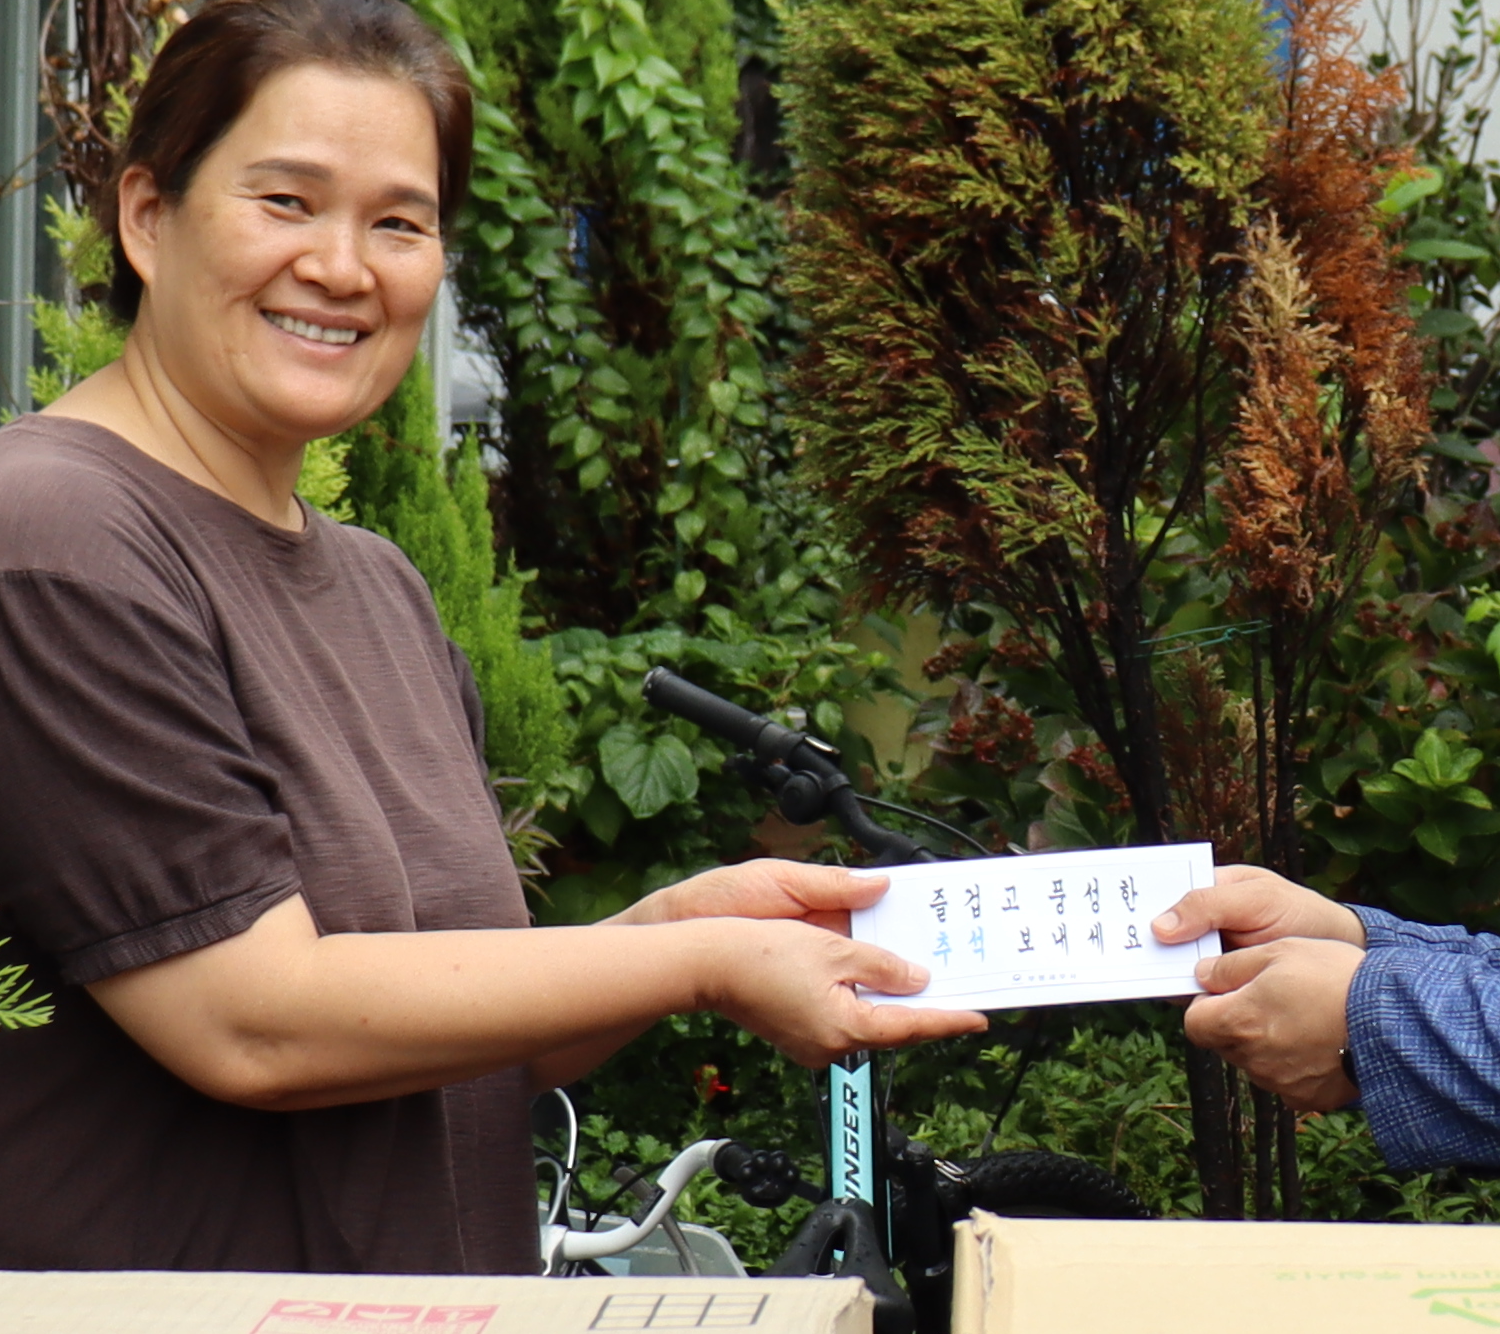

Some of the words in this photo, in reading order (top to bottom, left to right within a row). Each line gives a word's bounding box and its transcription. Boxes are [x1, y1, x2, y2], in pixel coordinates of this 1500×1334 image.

[929, 882, 1021, 924] 즐겁고
[1047, 875, 1140, 915] 풍성한
[932, 925, 986, 965] 추석
[1017, 921, 1143, 955] 보내세요
